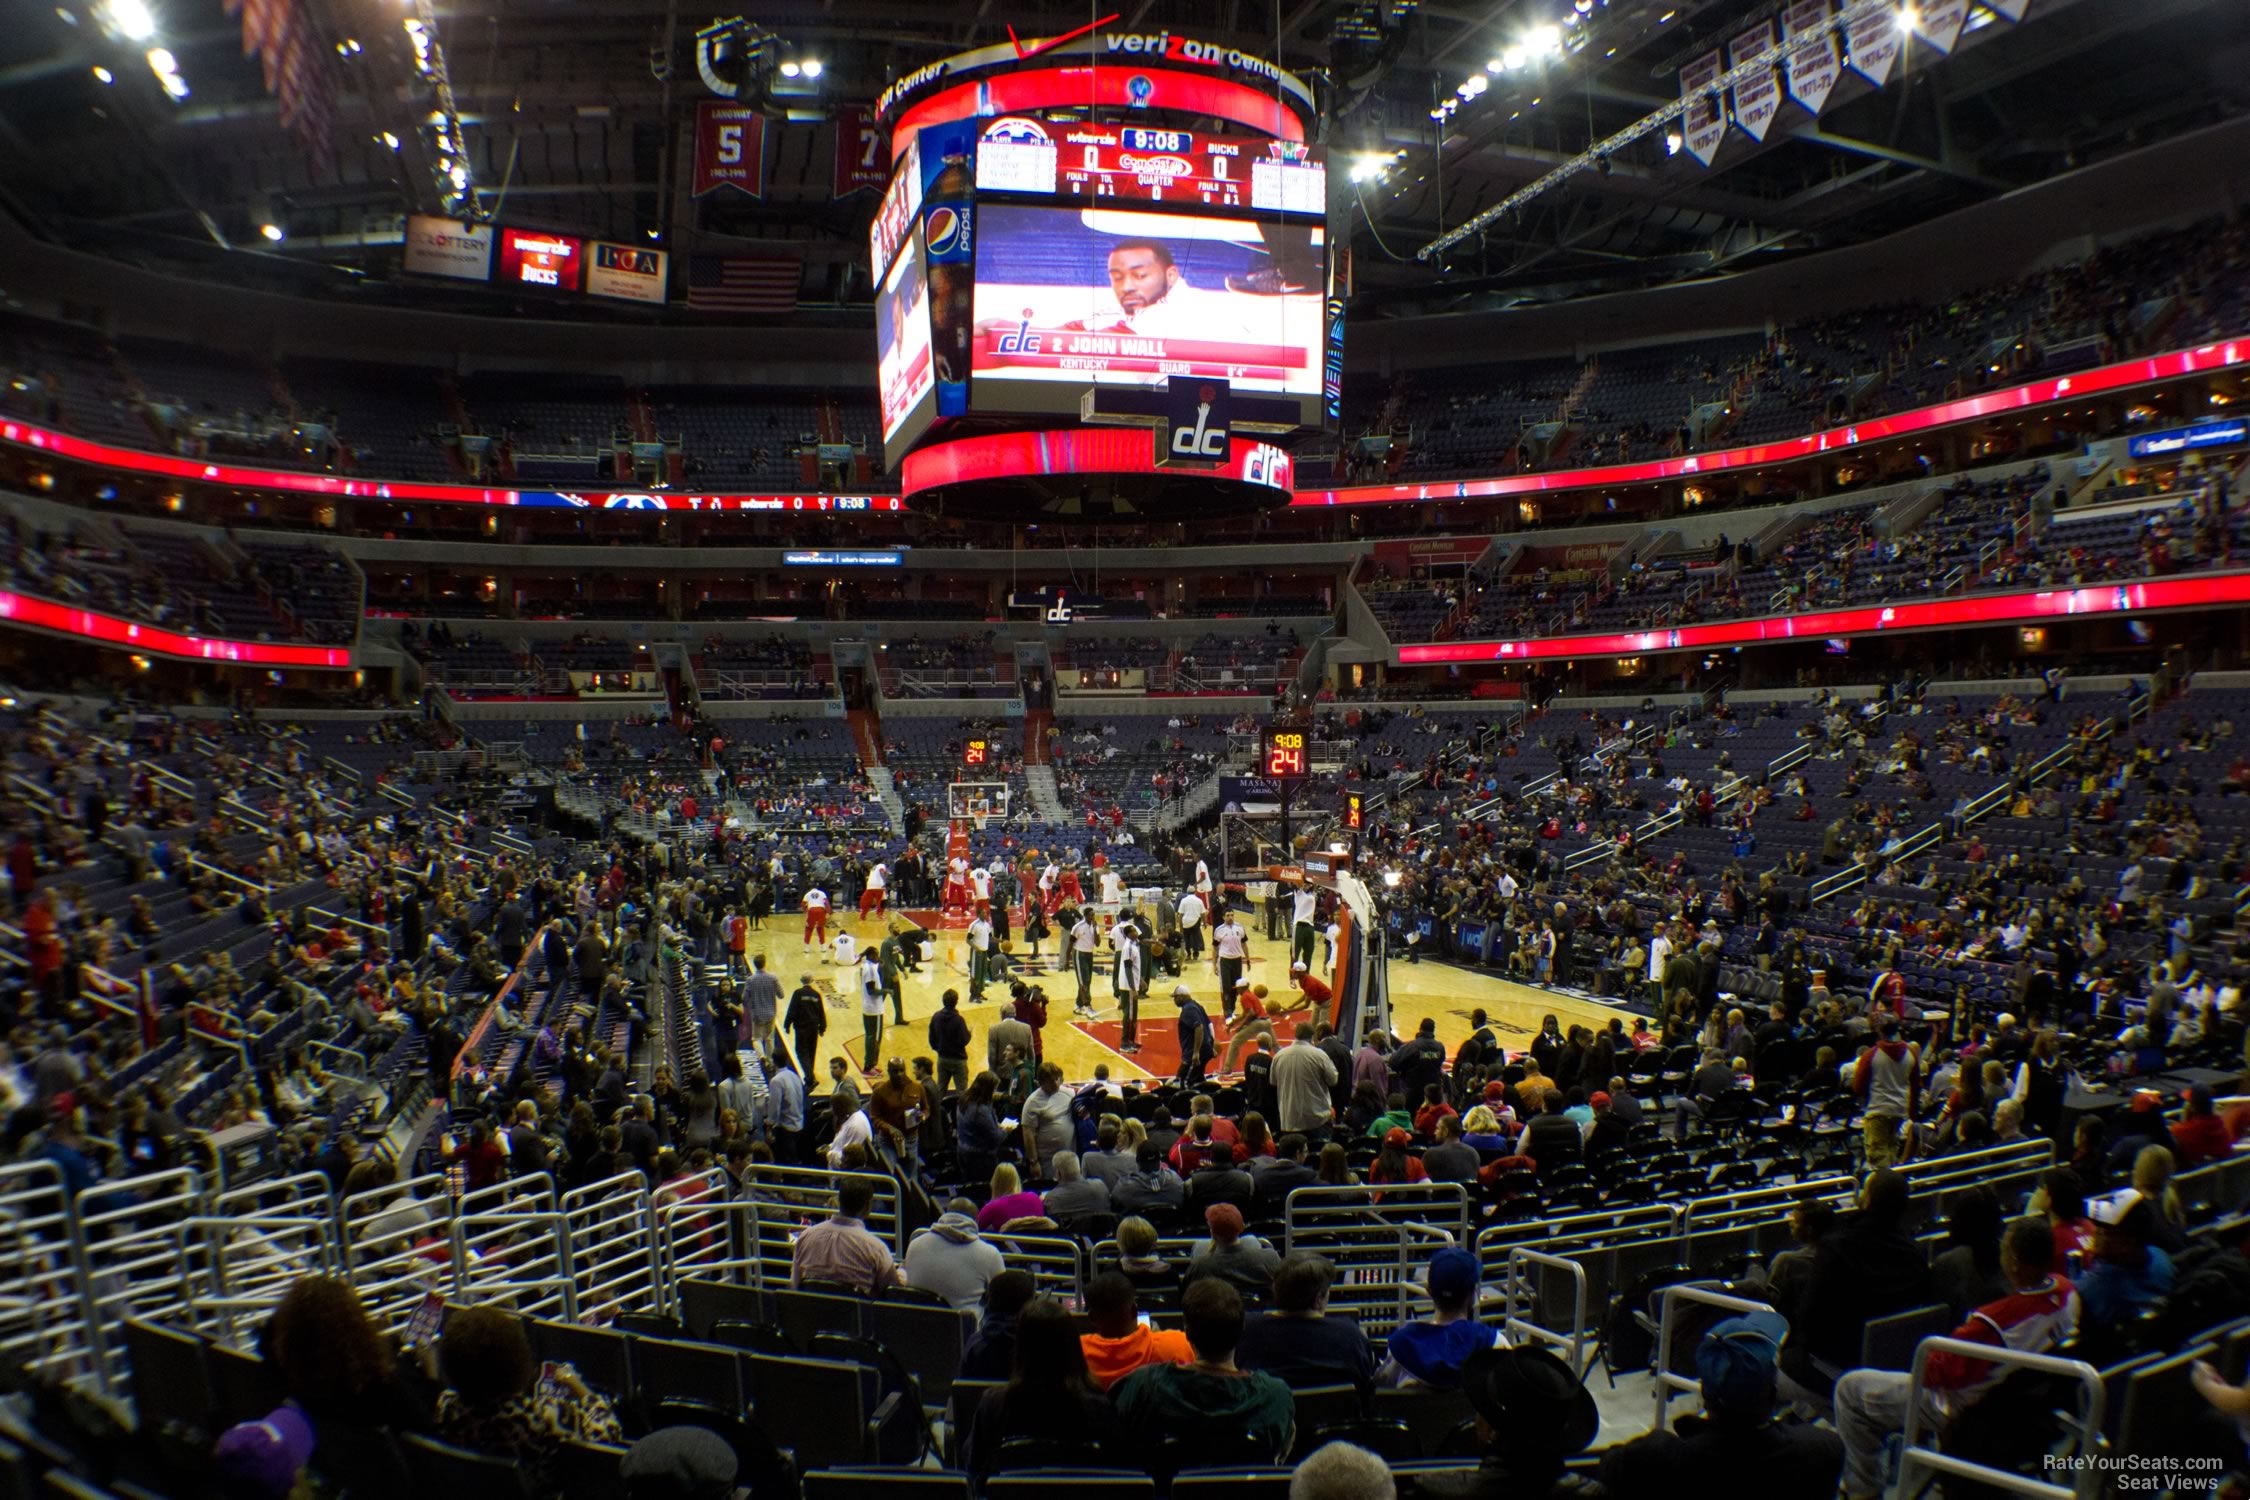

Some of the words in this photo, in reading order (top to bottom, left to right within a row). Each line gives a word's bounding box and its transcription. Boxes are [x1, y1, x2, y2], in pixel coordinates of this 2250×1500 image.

[1106, 29, 1220, 66] verizon
[1228, 48, 1285, 81] Center
[895, 61, 944, 97] Center
[717, 124, 743, 164] 5
[859, 128, 880, 167] 7
[1134, 131, 1180, 151] 9:08
[1084, 145, 1098, 170] 0
[1207, 143, 1239, 156] BUCKS
[1213, 156, 1228, 179] 0
[1066, 172, 1089, 182] FOULS
[1100, 173, 1113, 183] TOL
[1138, 174, 1174, 187] QUARTER
[1152, 186, 1162, 200] 0
[1197, 182, 1220, 192] FOULS
[960, 207, 971, 252] pepsi
[1052, 338, 1063, 352] 2
[1068, 336, 1116, 355] JOHN
[1120, 338, 1167, 357] WALL
[1060, 357, 1109, 370] KENTUCKY
[1158, 363, 1191, 375] GUARD
[1172, 401, 1226, 456] dc
[794, 498, 803, 509] 0
[840, 497, 865, 509] 9:08
[889, 498, 899, 510] 0
[1565, 547, 1599, 562] Captain
[653, 703, 666, 711] 107
[828, 702, 841, 711] 106
[970, 741, 984, 749] 9:08
[1275, 734, 1302, 748] 9:08
[968, 749, 983, 762] 24
[1271, 750, 1299, 773] 24
